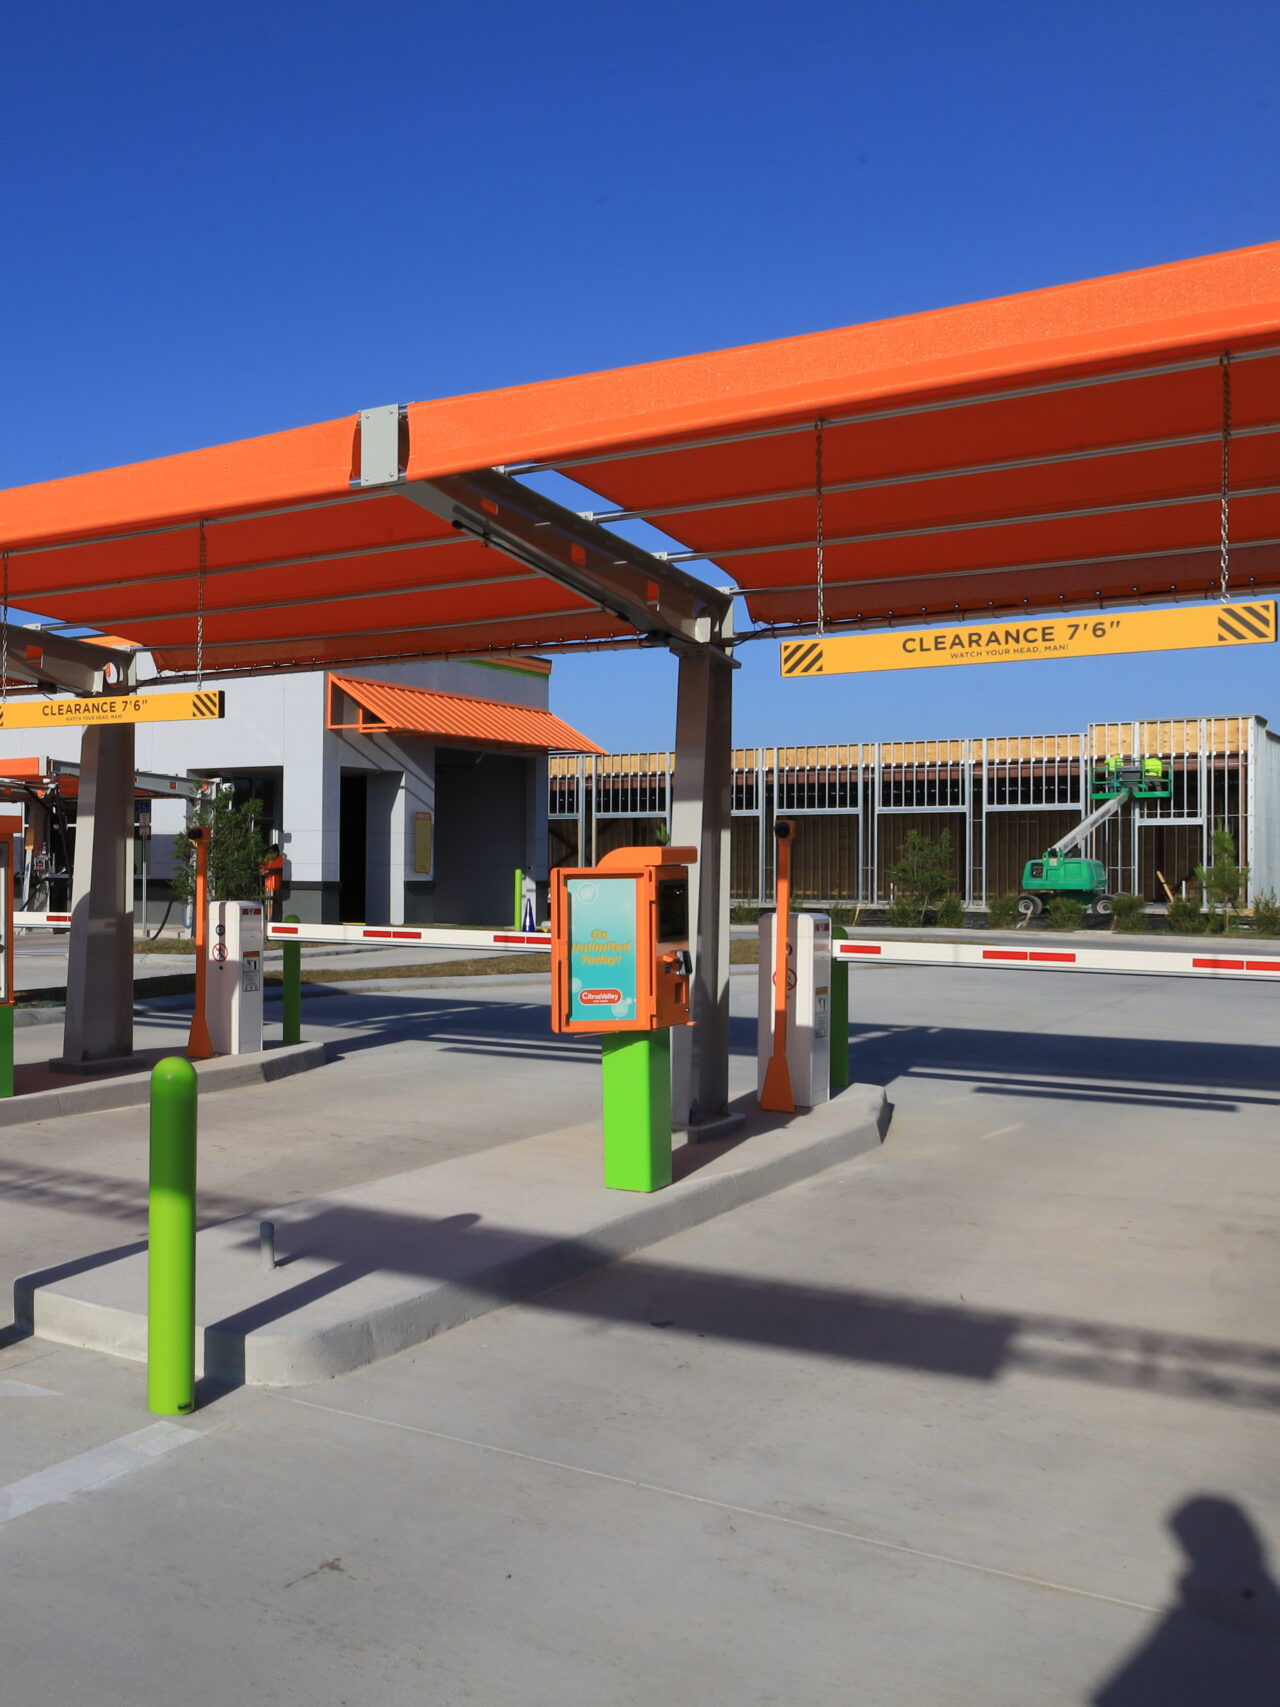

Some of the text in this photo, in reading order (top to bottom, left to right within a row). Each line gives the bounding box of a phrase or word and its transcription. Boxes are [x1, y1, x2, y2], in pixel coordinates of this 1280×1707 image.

[901, 620, 1121, 653] CLEARANCE 7'6"
[949, 644, 1069, 659] WATCH YOUR HEAD, MAN!
[42, 701, 117, 716] CLEARANCE
[591, 929, 608, 939] Go
[571, 942, 630, 952] Unlimited
[580, 955, 621, 966] Today!
